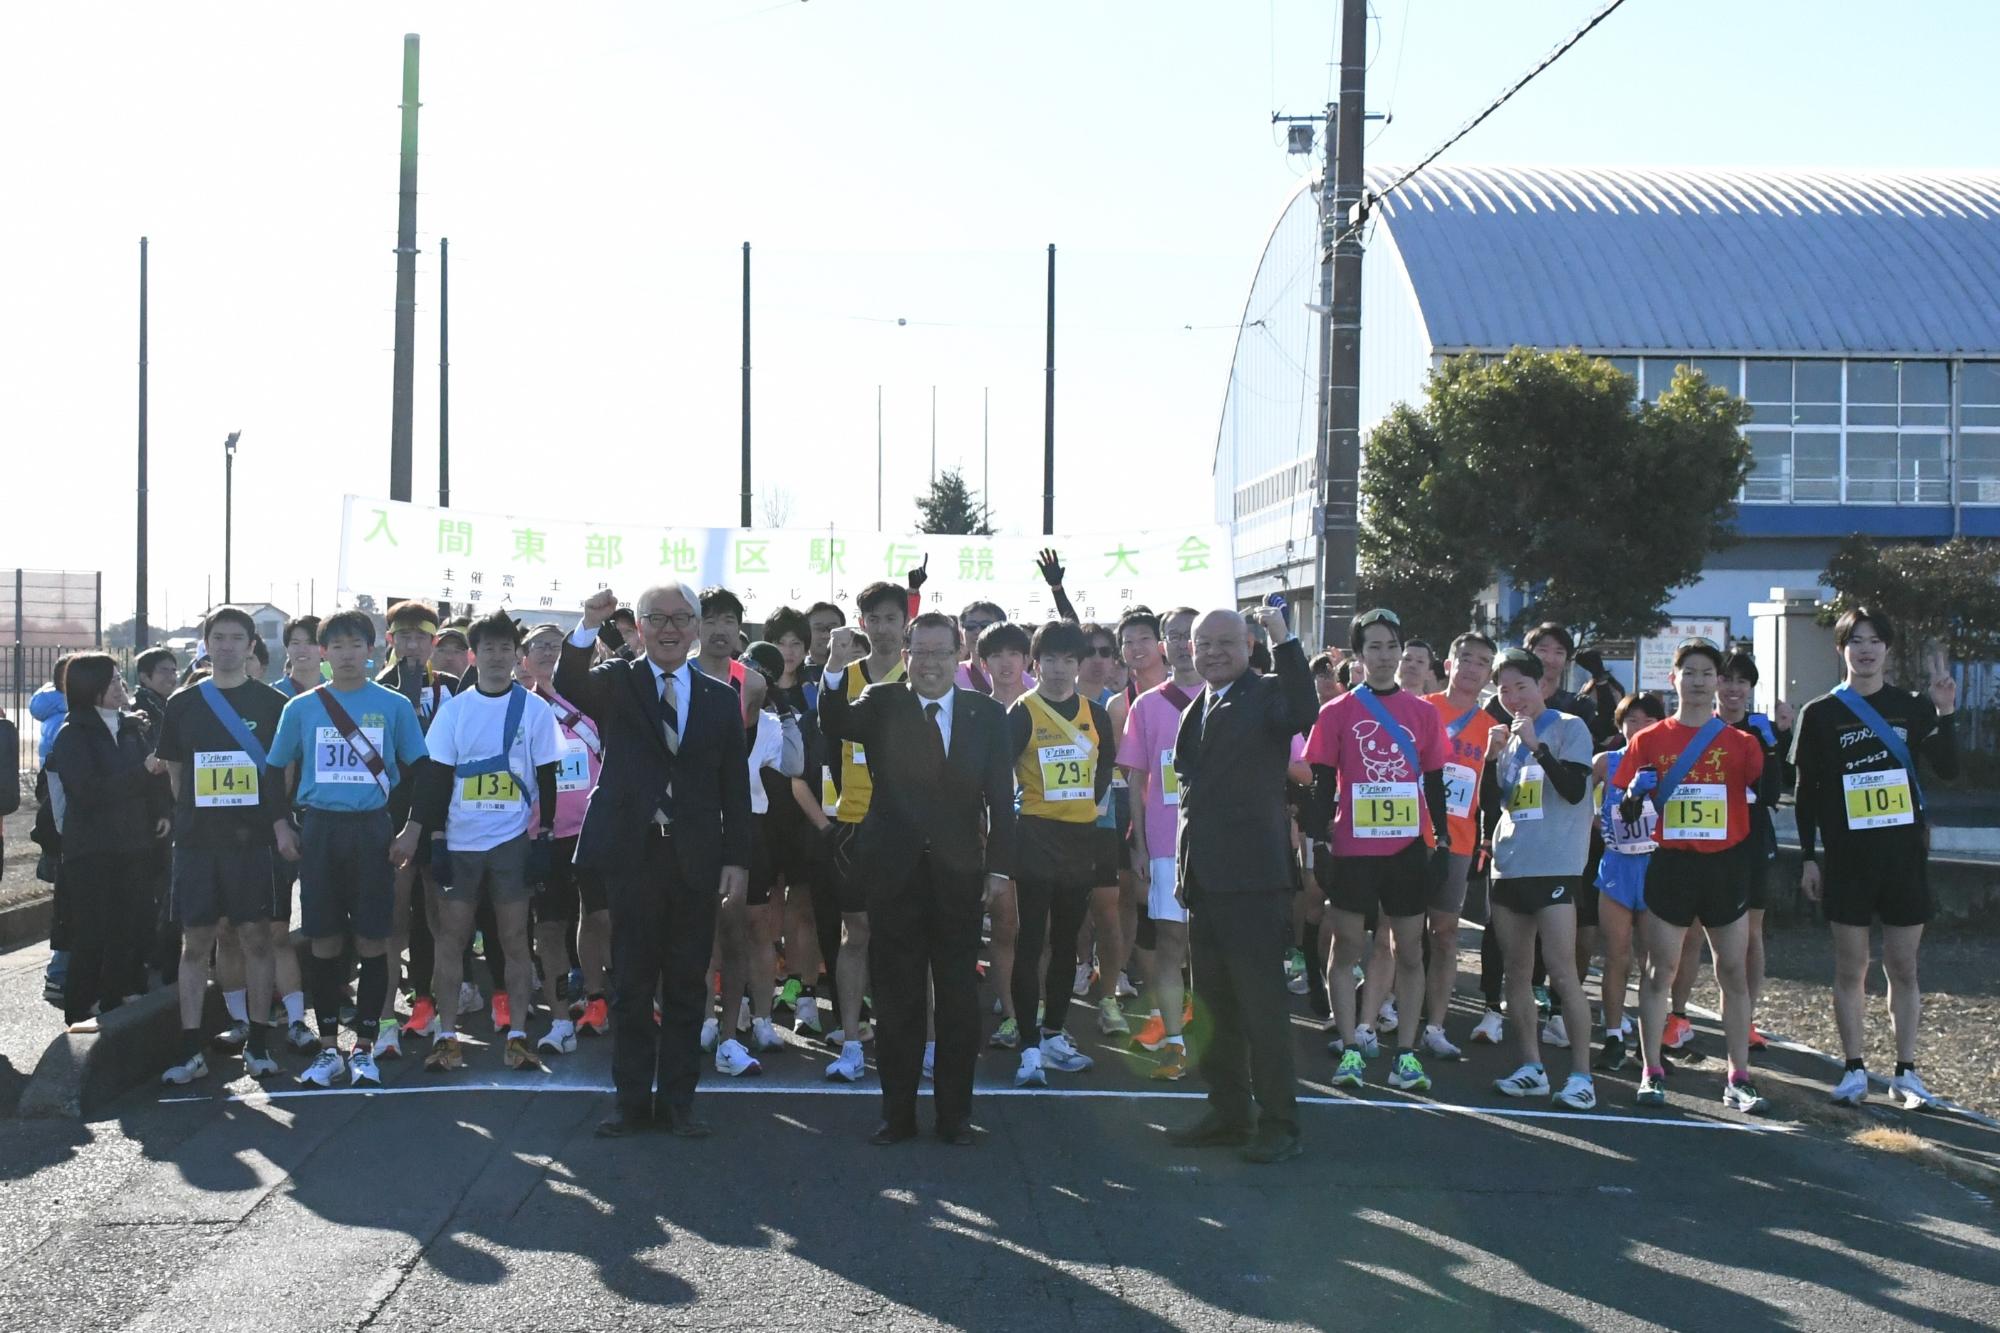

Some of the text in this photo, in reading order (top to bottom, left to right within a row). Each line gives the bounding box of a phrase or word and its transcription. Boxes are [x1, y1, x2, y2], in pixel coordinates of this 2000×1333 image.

[364, 508, 1210, 582] 入間東部地区駅伝競大会
[212, 768, 250, 791] 14-1
[1056, 761, 1091, 784] 29-1
[477, 774, 514, 796] 13-1
[1371, 799, 1410, 822] 19-1
[1864, 788, 1904, 812] 10-1
[1680, 800, 1719, 824] 15-1
